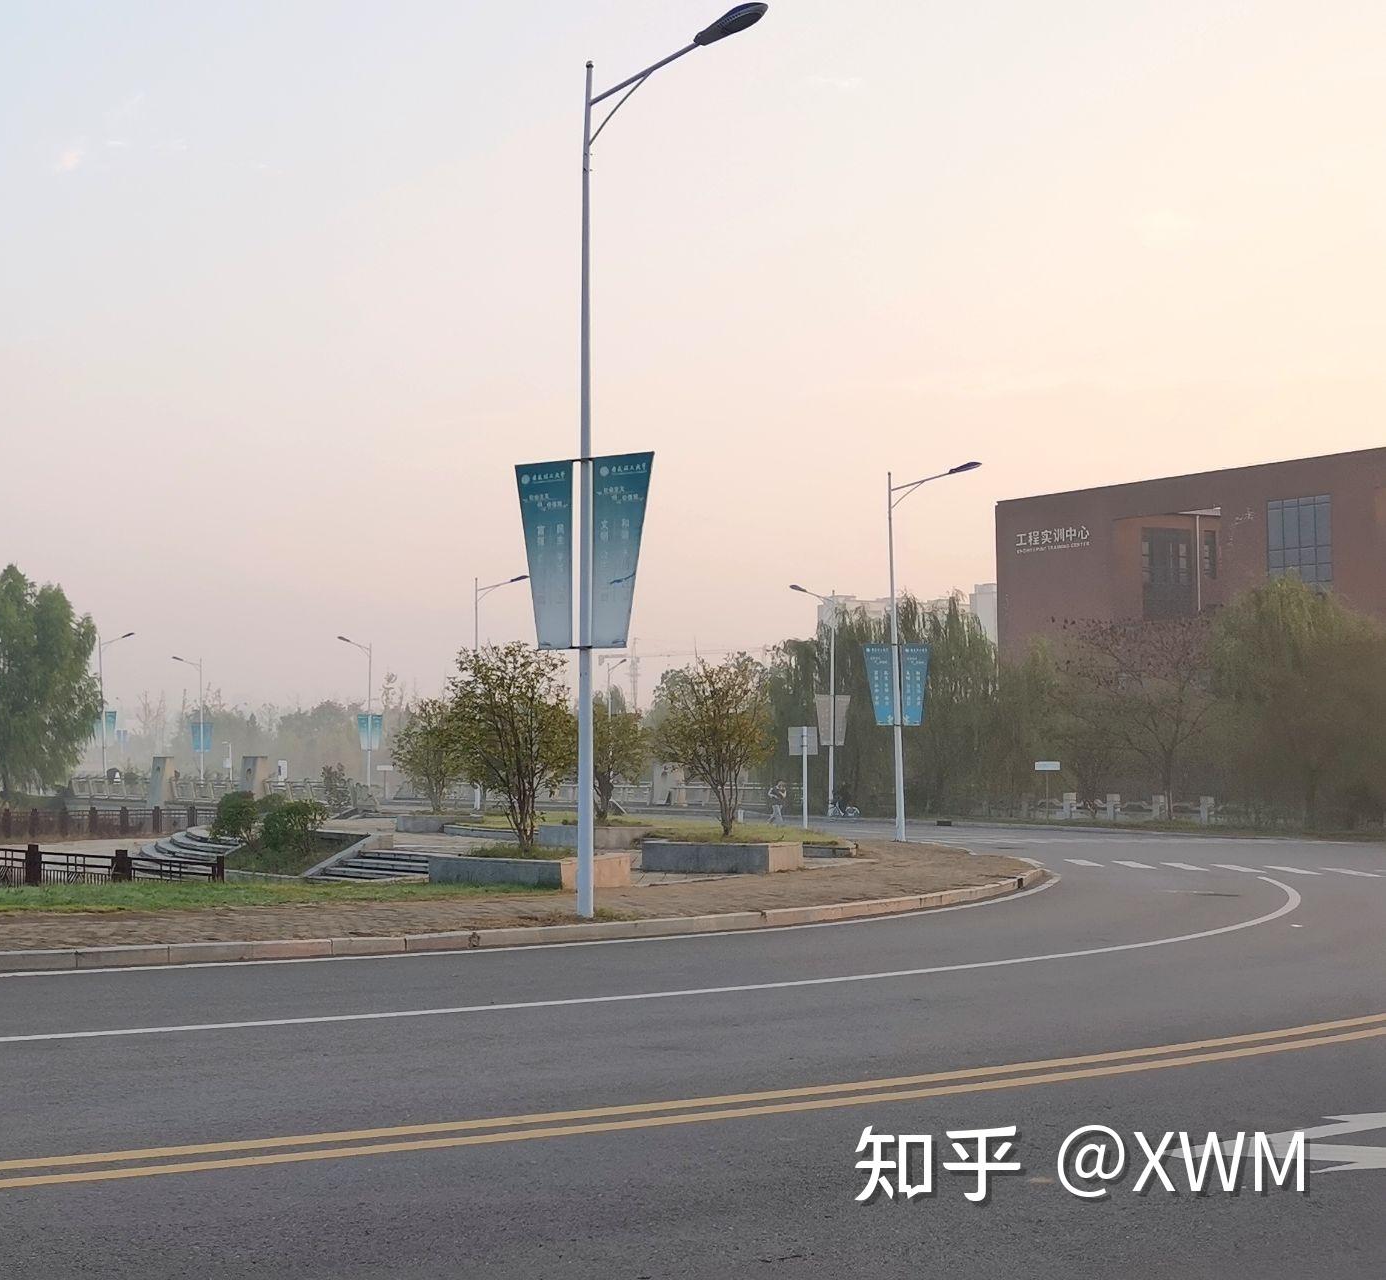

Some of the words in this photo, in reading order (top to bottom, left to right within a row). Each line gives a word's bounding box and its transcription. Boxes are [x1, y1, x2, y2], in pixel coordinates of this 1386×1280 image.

[1015, 525, 1090, 546] 工程实训中心
